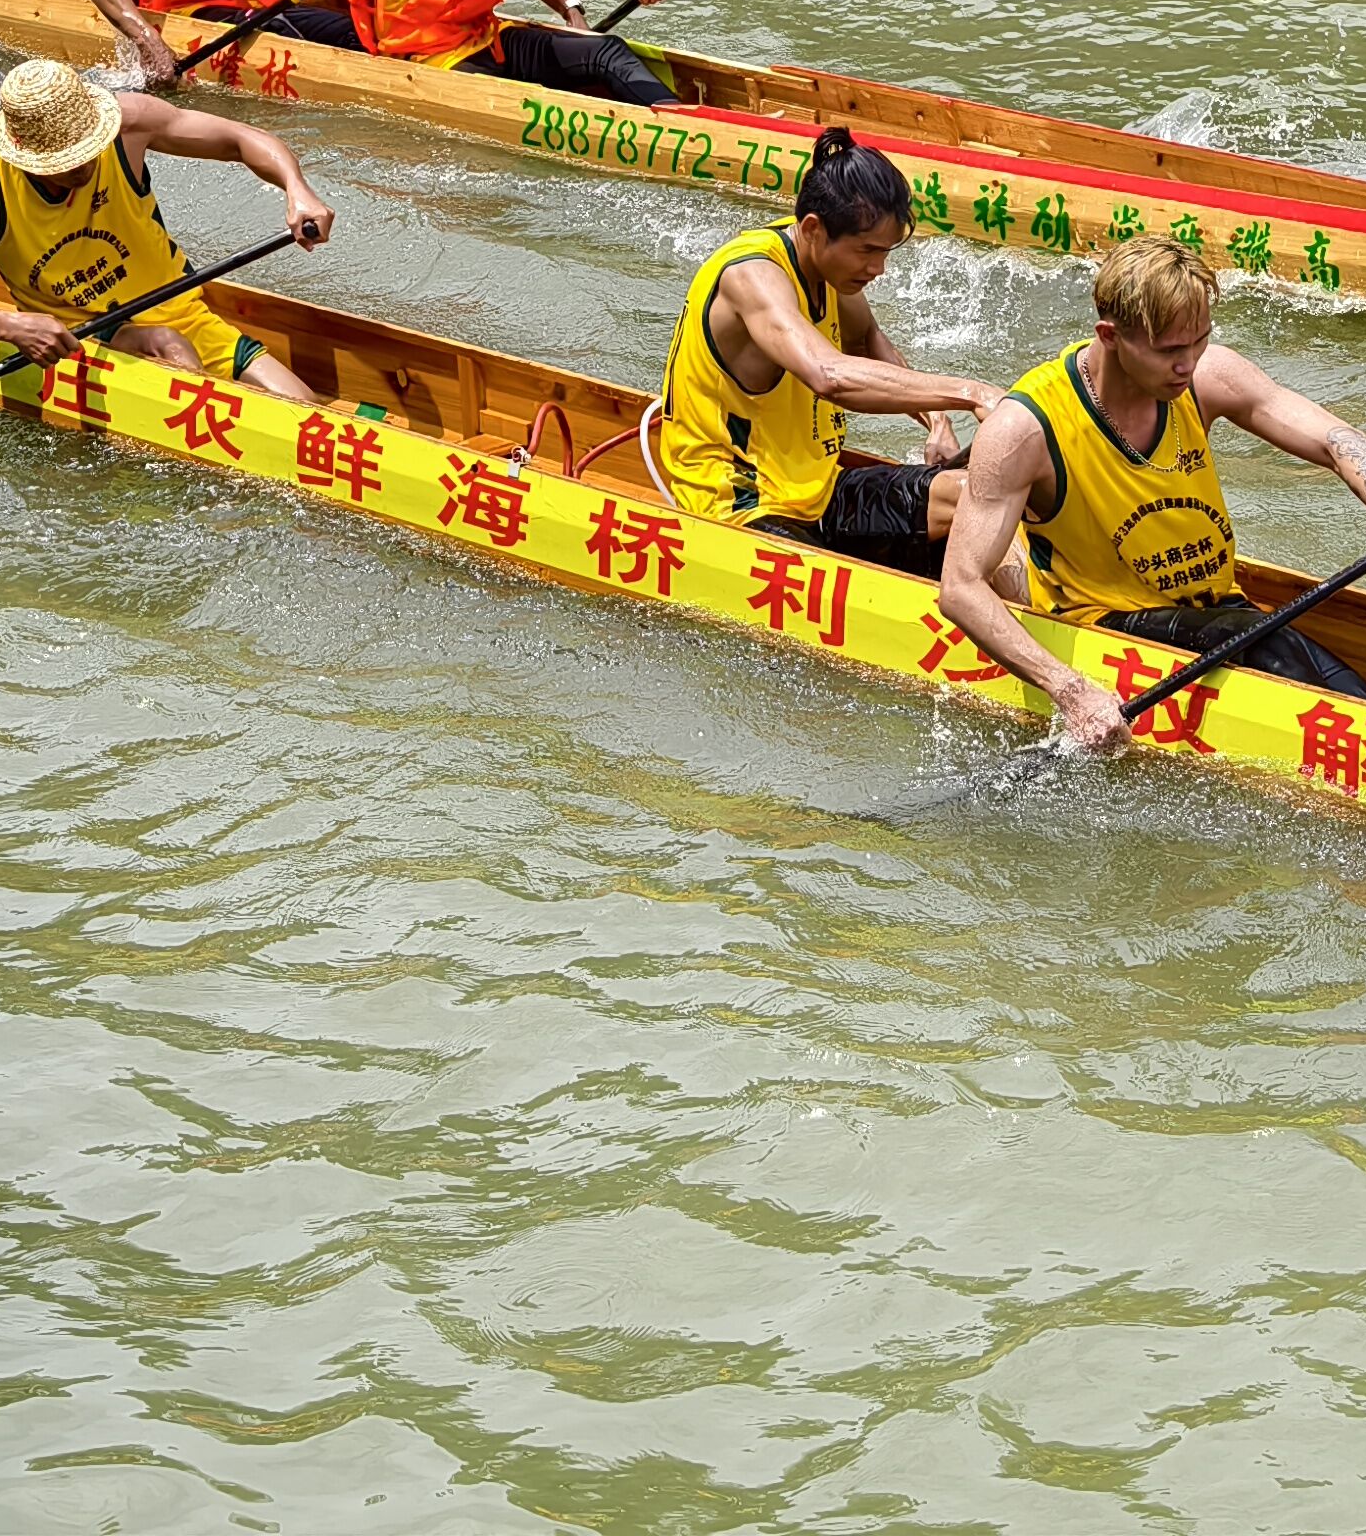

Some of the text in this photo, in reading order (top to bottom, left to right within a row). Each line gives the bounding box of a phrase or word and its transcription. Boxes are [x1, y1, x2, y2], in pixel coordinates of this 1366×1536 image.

[1132, 535, 1214, 575] 沙头商会杯
